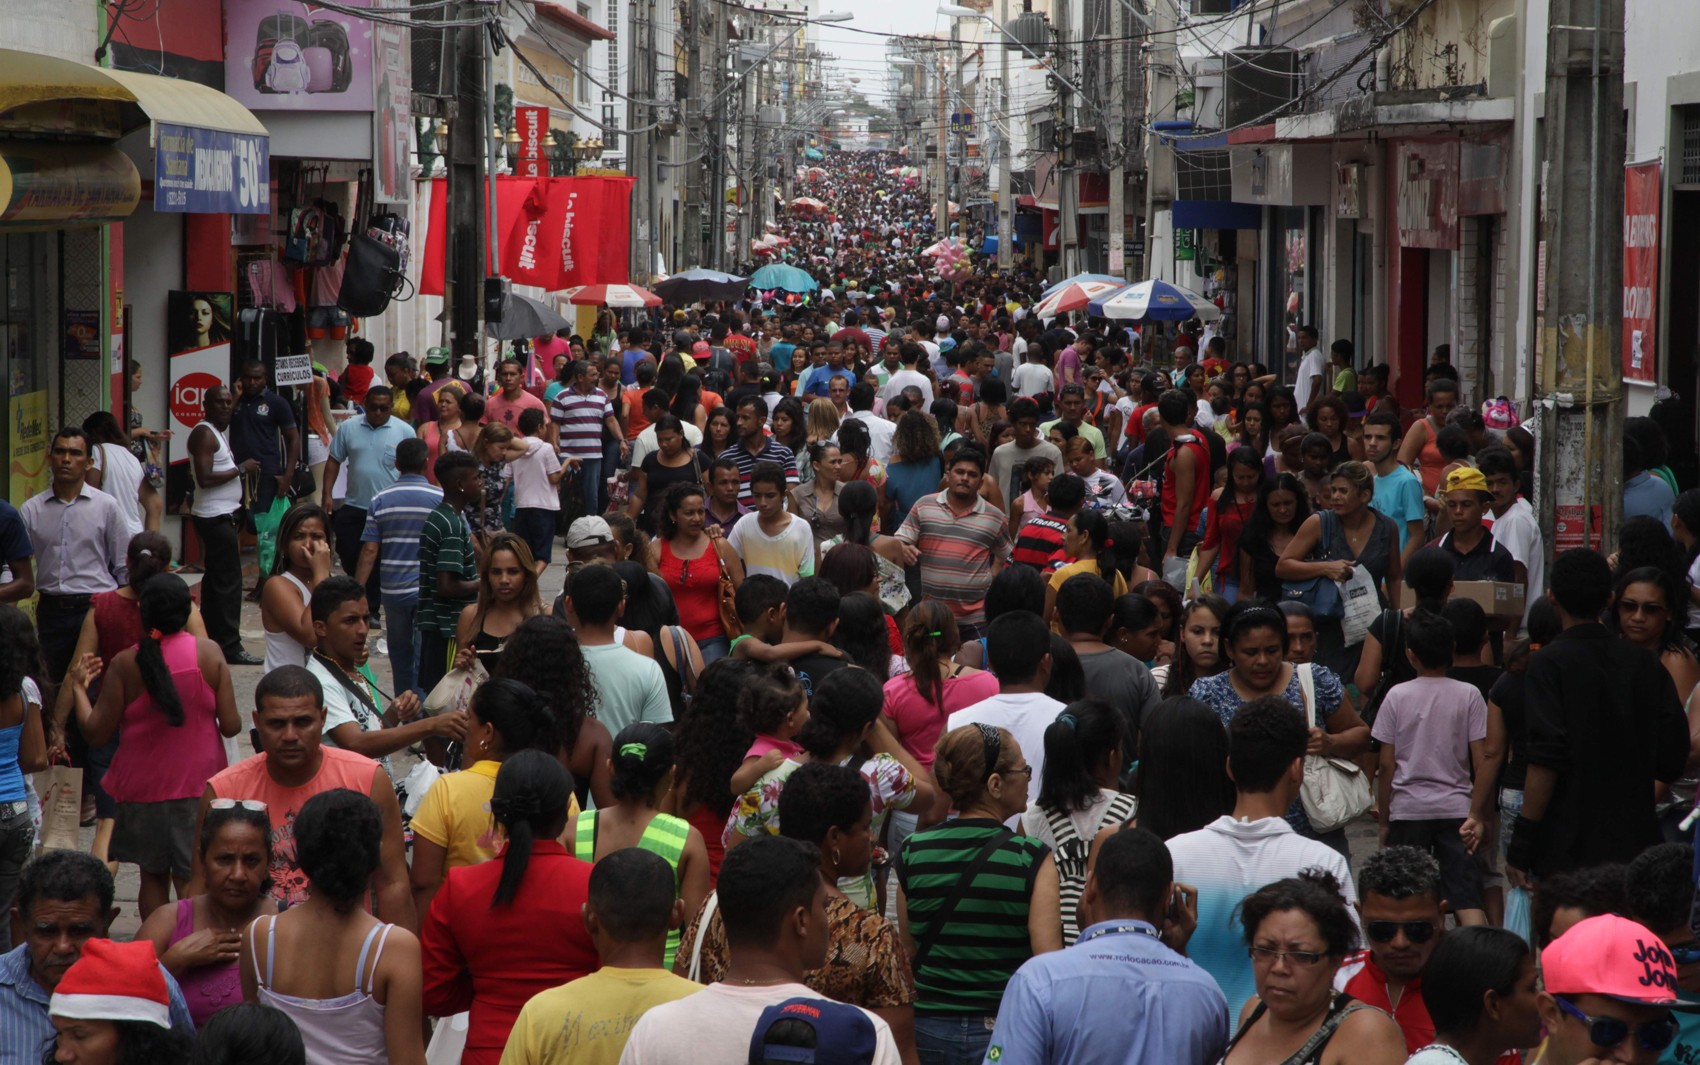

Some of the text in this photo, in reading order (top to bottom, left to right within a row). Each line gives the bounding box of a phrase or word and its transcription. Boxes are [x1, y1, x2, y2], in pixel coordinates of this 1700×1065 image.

[525, 110, 538, 161] biscuit
[194, 147, 232, 192] MEDICAMENTOS
[518, 219, 541, 270] iscuit
[561, 212, 575, 272] biscuit
[276, 356, 310, 370] ESTAMOS RECEBENDO
[277, 368, 311, 382] CURRÍCULOS
[1027, 517, 1067, 533] TROBRA
[1633, 939, 1674, 970] John
[1638, 962, 1678, 992] John
